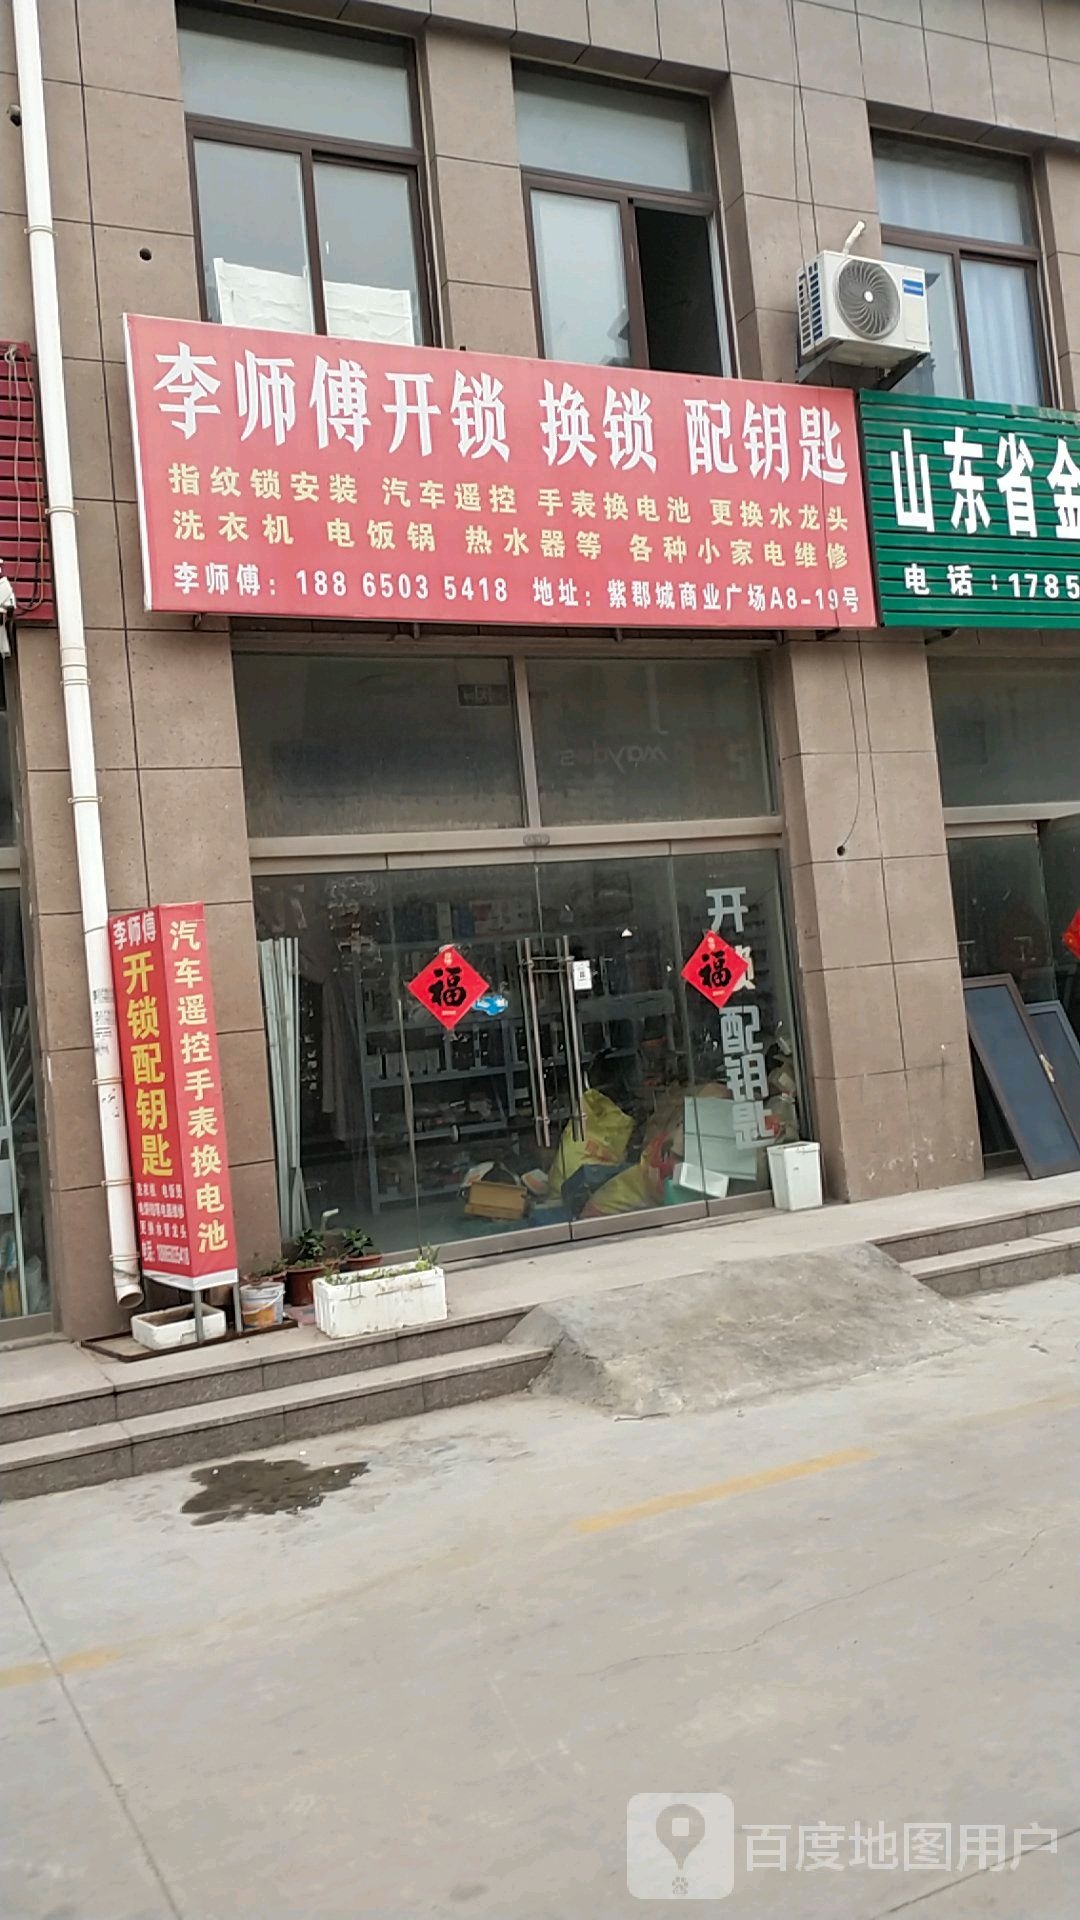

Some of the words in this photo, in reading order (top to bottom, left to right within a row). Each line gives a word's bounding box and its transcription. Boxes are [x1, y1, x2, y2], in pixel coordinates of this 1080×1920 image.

[153, 341, 510, 463] 李师傅开锁
[539, 378, 657, 474] 换锁
[684, 399, 848, 485] 配钥匙
[168, 463, 358, 504] 指纹锁安装
[381, 477, 517, 514] 汽车遥控
[538, 488, 691, 524] 手表换电池
[709, 498, 848, 532] 更换水龙头
[890, 426, 1080, 540] 山东省金
[172, 510, 294, 545] 洗衣机
[326, 518, 436, 552] 电饭锅
[465, 525, 601, 560] 热水器等
[629, 534, 849, 570] 各种小家电维修
[296, 570, 346, 596] 188
[362, 572, 429, 599] 6503
[444, 576, 508, 602] 5418
[112, 910, 157, 951] 李师傅
[428, 966, 467, 1007] 福
[698, 950, 732, 989] 福
[122, 951, 174, 1177] 开锁配钥匙
[169, 920, 229, 1253] 汽车遥控手表换电池
